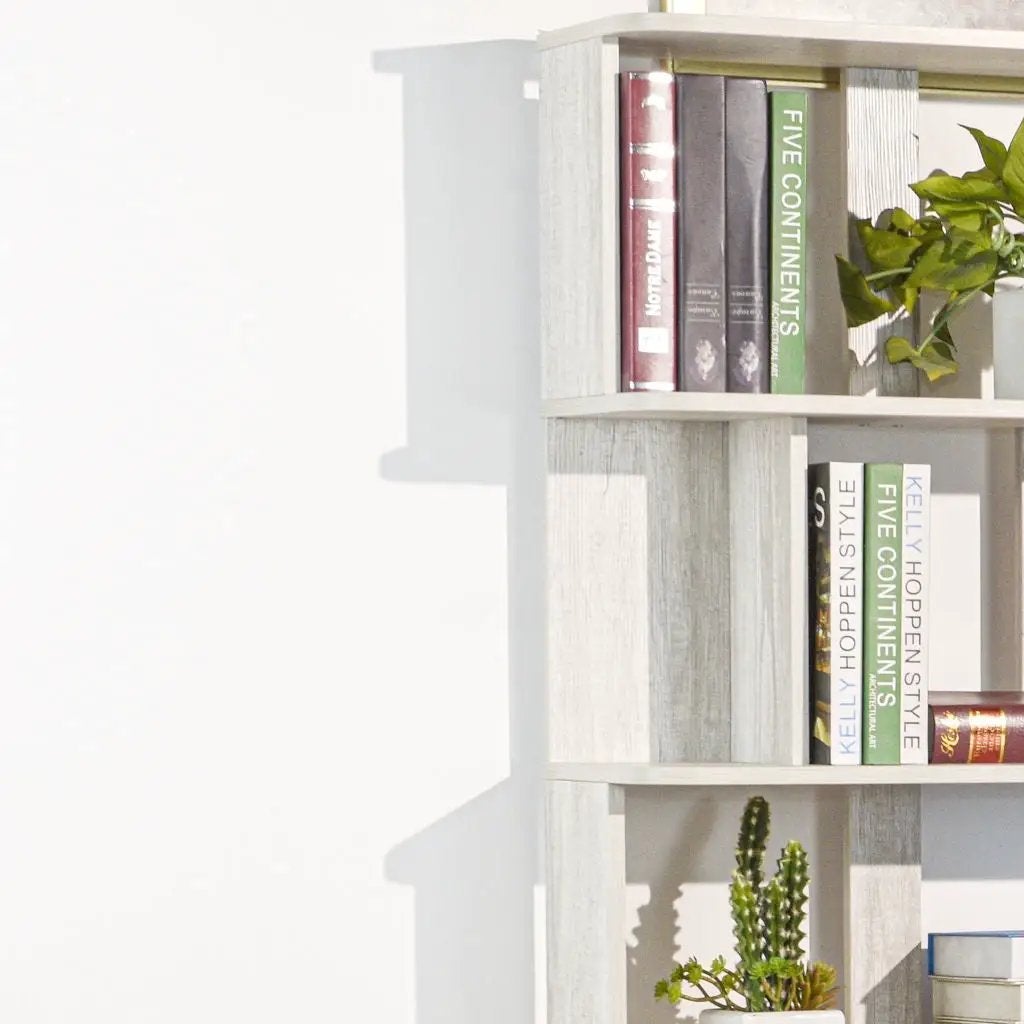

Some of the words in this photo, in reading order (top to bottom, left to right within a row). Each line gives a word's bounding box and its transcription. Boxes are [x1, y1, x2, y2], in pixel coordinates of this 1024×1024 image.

[782, 109, 803, 165] FIVE
[779, 174, 802, 336] CONTINENTS
[839, 479, 856, 558] STYLE
[877, 484, 897, 538] FIVE
[904, 475, 923, 553] KELLY
[839, 565, 856, 671] HOPPEN
[876, 546, 897, 707] CONTINENTS
[904, 561, 922, 664] HOPPEN
[839, 679, 856, 756] KELLY
[868, 673, 877, 734] ARCHITECTURAL
[903, 672, 921, 750] STYLE
